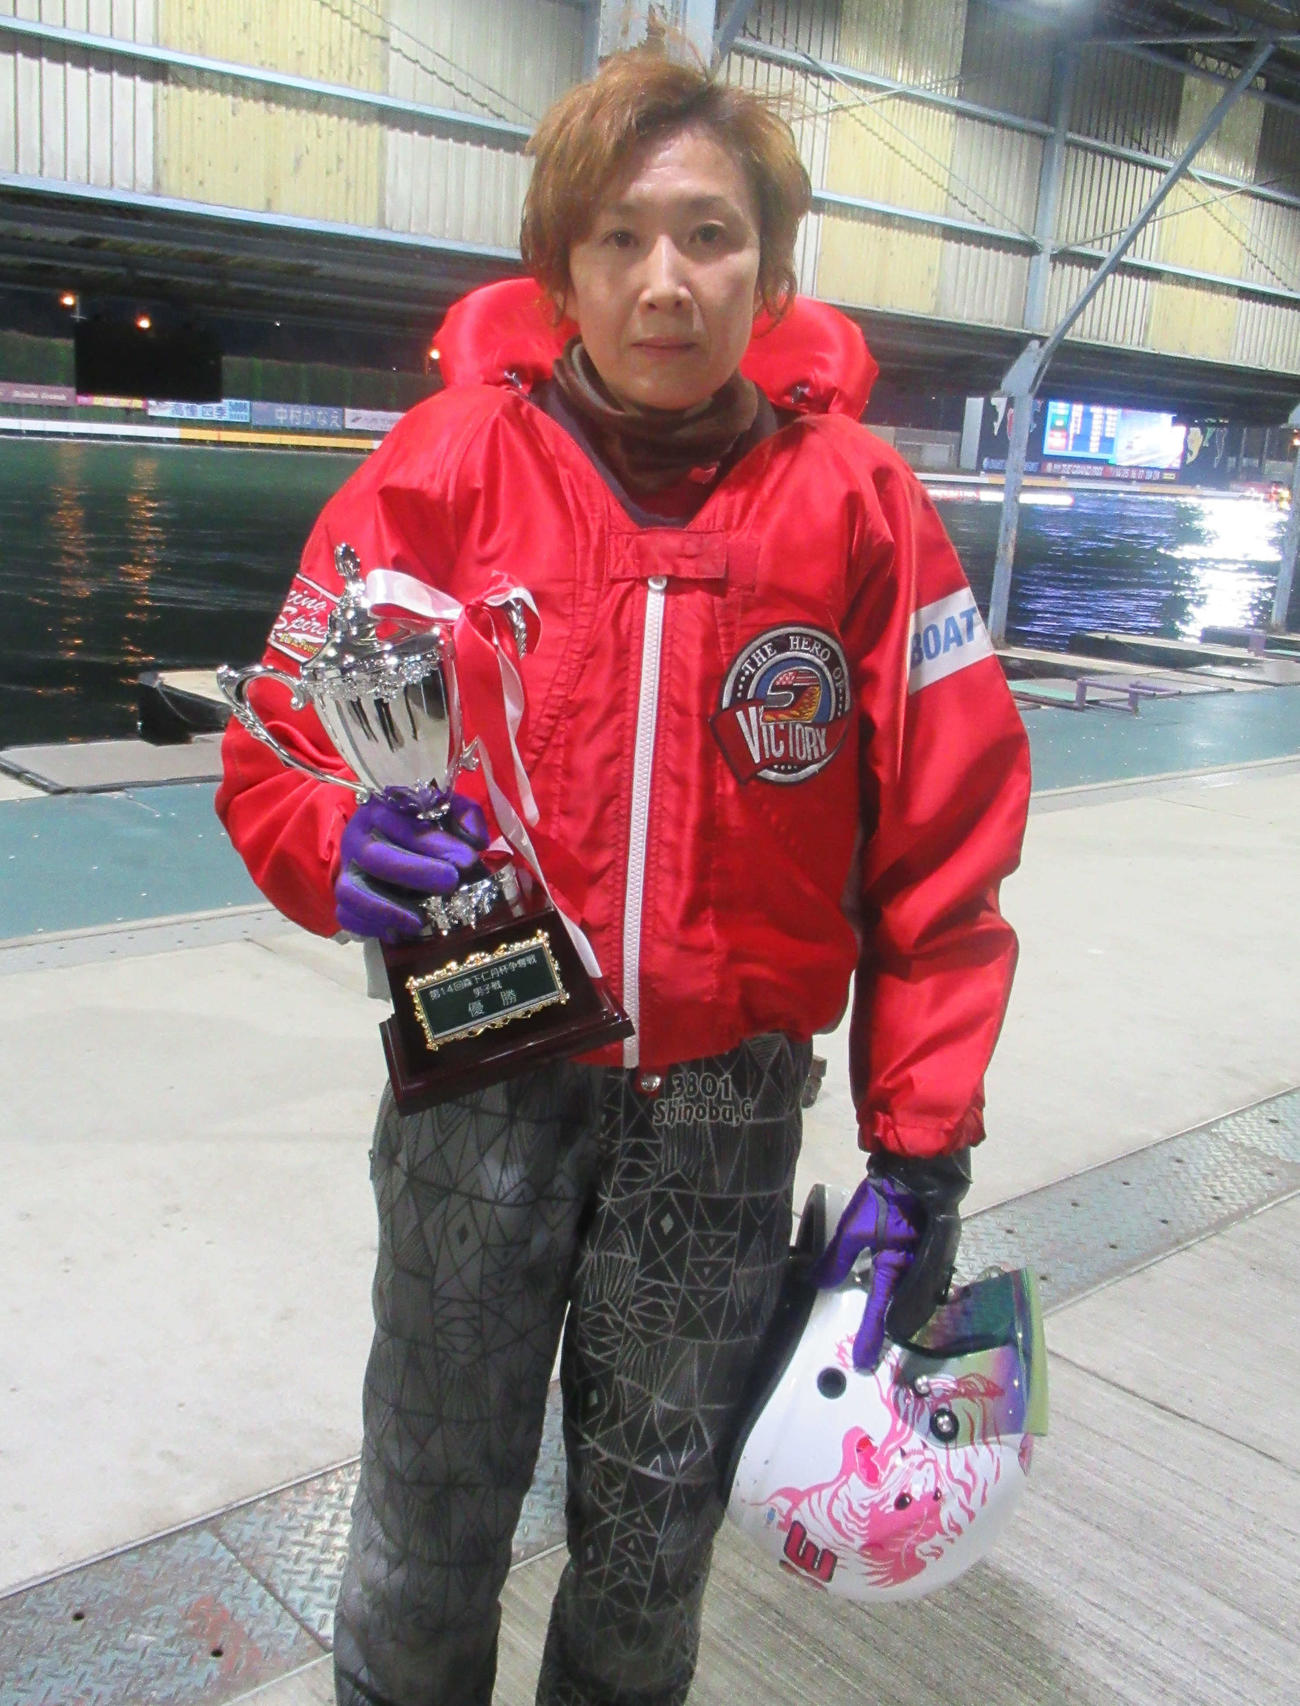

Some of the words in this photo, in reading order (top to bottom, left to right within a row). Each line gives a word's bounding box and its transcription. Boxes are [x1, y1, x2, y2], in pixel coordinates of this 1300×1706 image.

[741, 643, 777, 676] THE
[789, 635, 832, 662] HERO
[911, 606, 977, 669] BOAT
[736, 705, 828, 764] VICTORY
[671, 1071, 732, 1100] 3801
